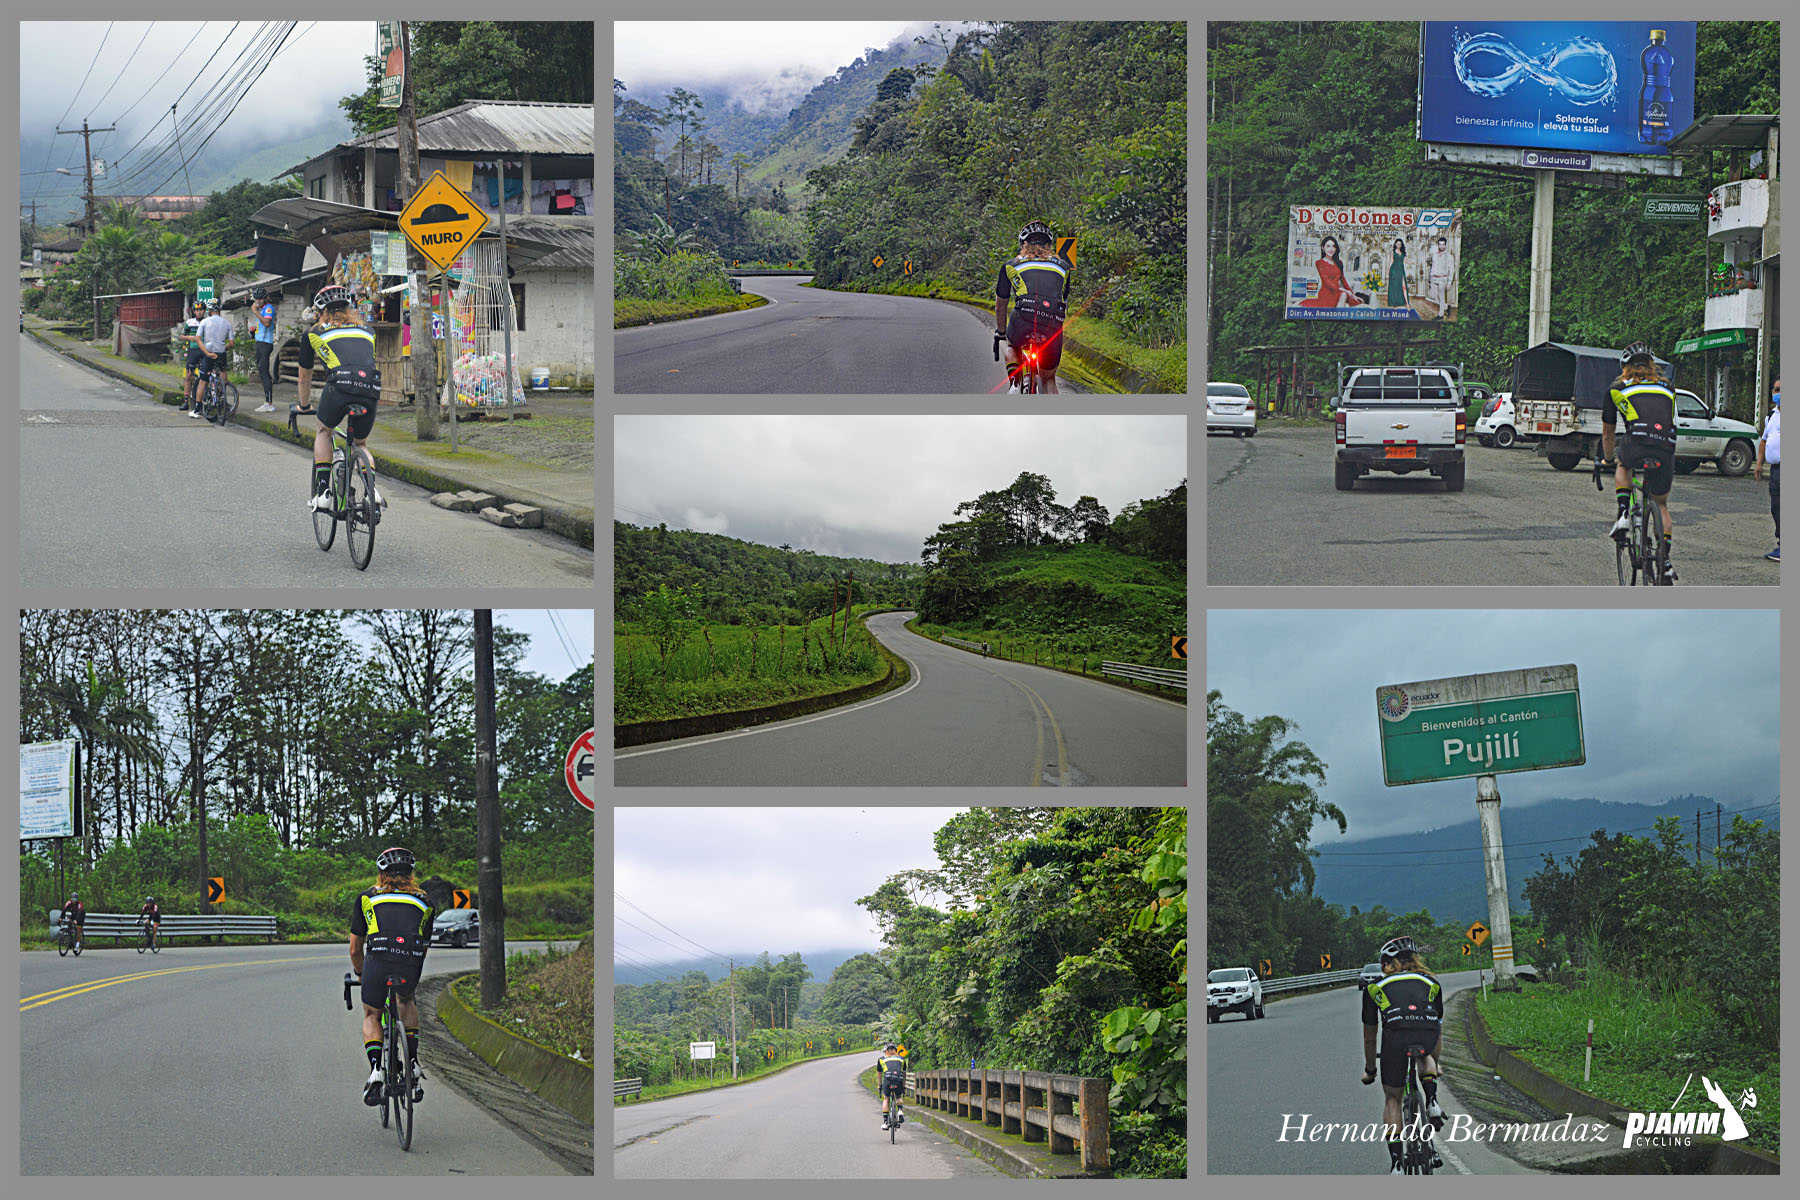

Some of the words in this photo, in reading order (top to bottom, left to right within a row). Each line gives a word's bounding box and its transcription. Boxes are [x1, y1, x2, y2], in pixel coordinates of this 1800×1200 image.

[1455, 116, 1499, 127] bienestar
[1501, 118, 1534, 129] infinito
[1555, 114, 1599, 125] Splendor
[1543, 122, 1569, 132] eleva
[1570, 123, 1582, 132] tu
[1583, 124, 1609, 134] salud
[1539, 157, 1586, 167] induvallas
[1656, 203, 1700, 213] SERVIENTREGA
[421, 231, 463, 246] MURO
[1316, 310, 1349, 318] Amazonas
[1350, 311, 1355, 319] y
[1411, 692, 1440, 702] ecuador
[1421, 716, 1485, 732] Bienvenidos
[1487, 714, 1497, 724] al
[1499, 710, 1538, 723] Cantón
[1443, 730, 1520, 768] Pujilí
